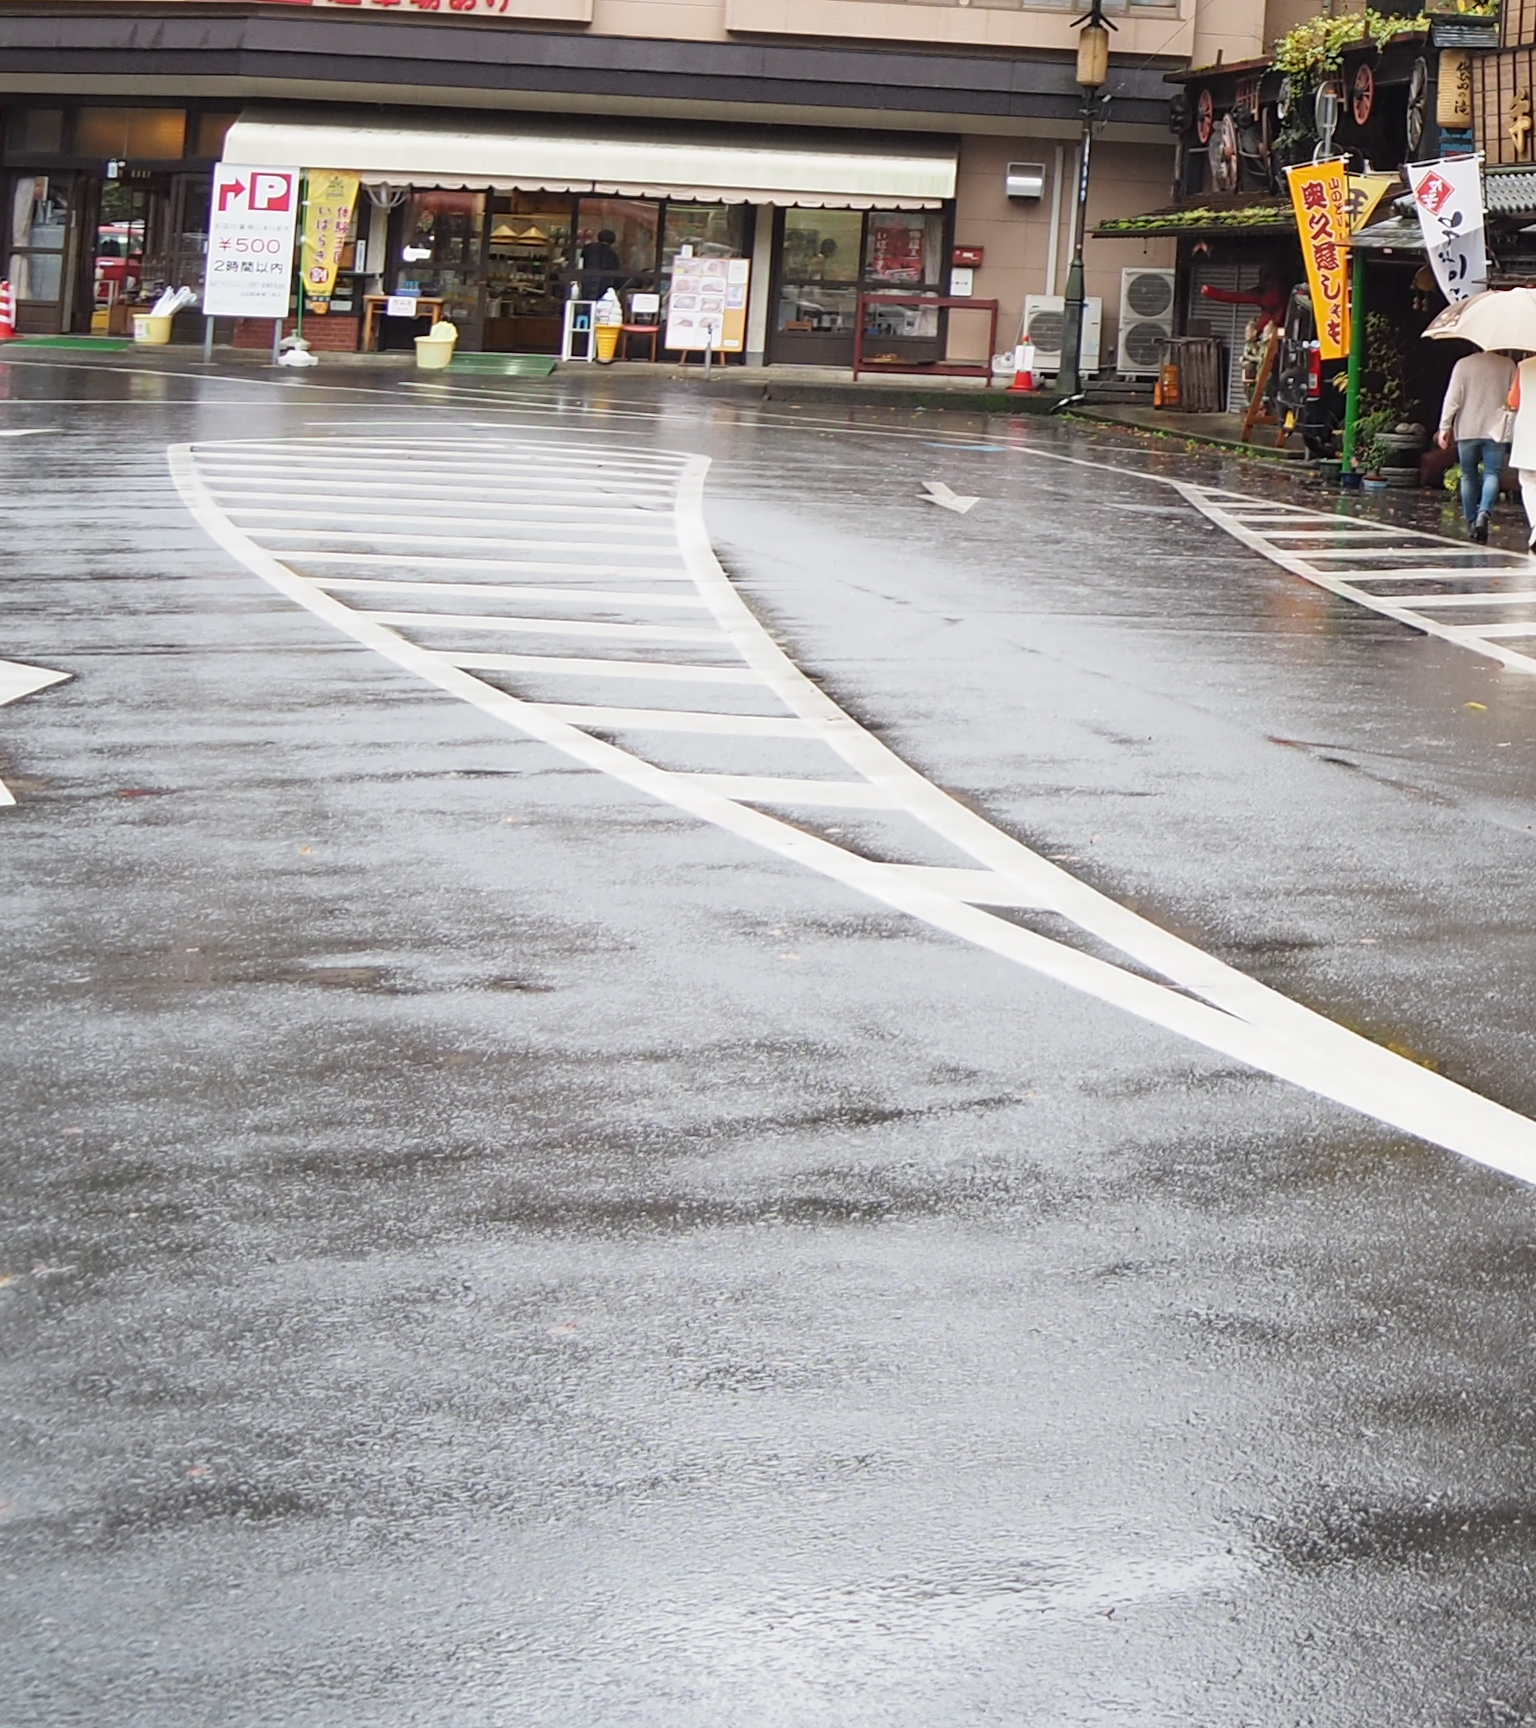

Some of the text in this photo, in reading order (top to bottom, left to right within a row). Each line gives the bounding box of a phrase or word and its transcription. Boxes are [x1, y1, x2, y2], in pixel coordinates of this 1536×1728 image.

[254, 174, 290, 210] P
[218, 237, 281, 254] ¥500
[213, 259, 284, 275] 2時間以内
[1300, 181, 1343, 346] 奥久慈しゃも
